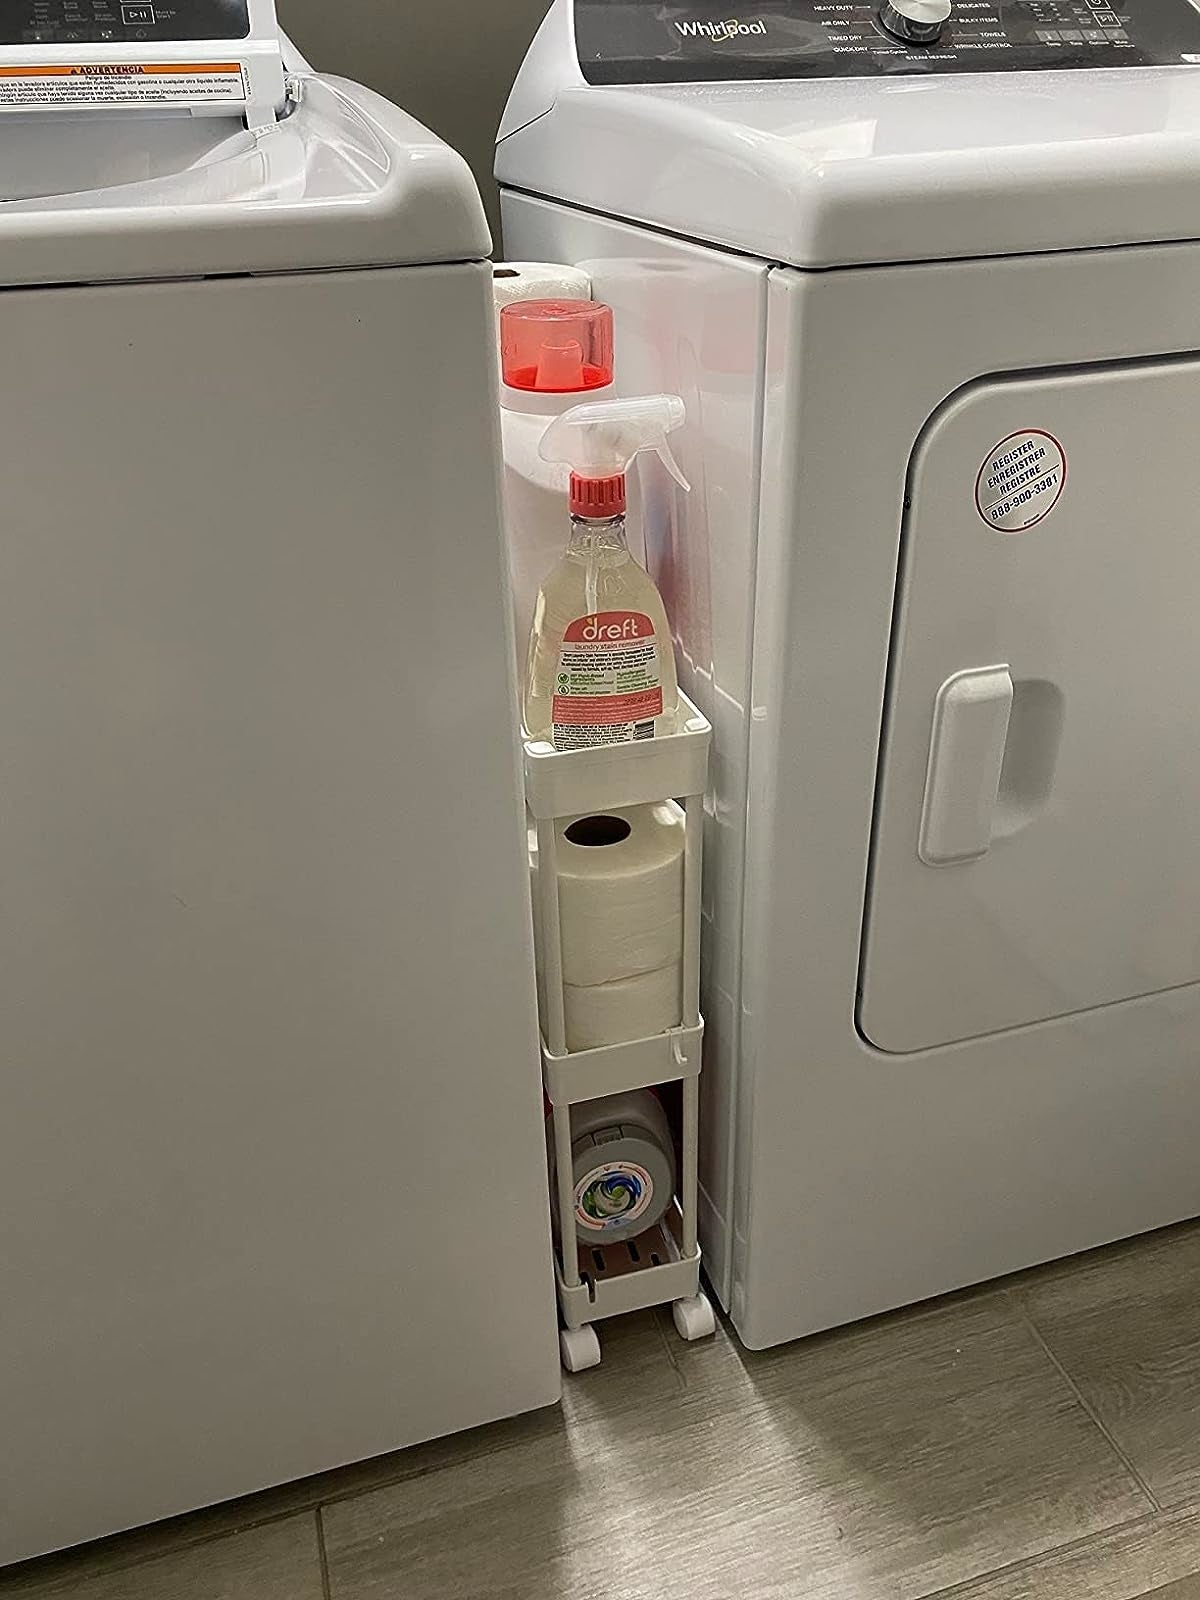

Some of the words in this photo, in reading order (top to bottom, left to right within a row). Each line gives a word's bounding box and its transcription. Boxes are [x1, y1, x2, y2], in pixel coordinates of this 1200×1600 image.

[674, 20, 767, 41] Whirlpool
[80, 66, 144, 74] ADVERTENCIA
[987, 447, 1046, 488] ENREGISTRER
[992, 440, 1034, 471] REGISTER
[1000, 464, 1041, 495] REGISTRE
[991, 473, 1058, 520] 888-900-3381
[582, 618, 638, 640] dreft
